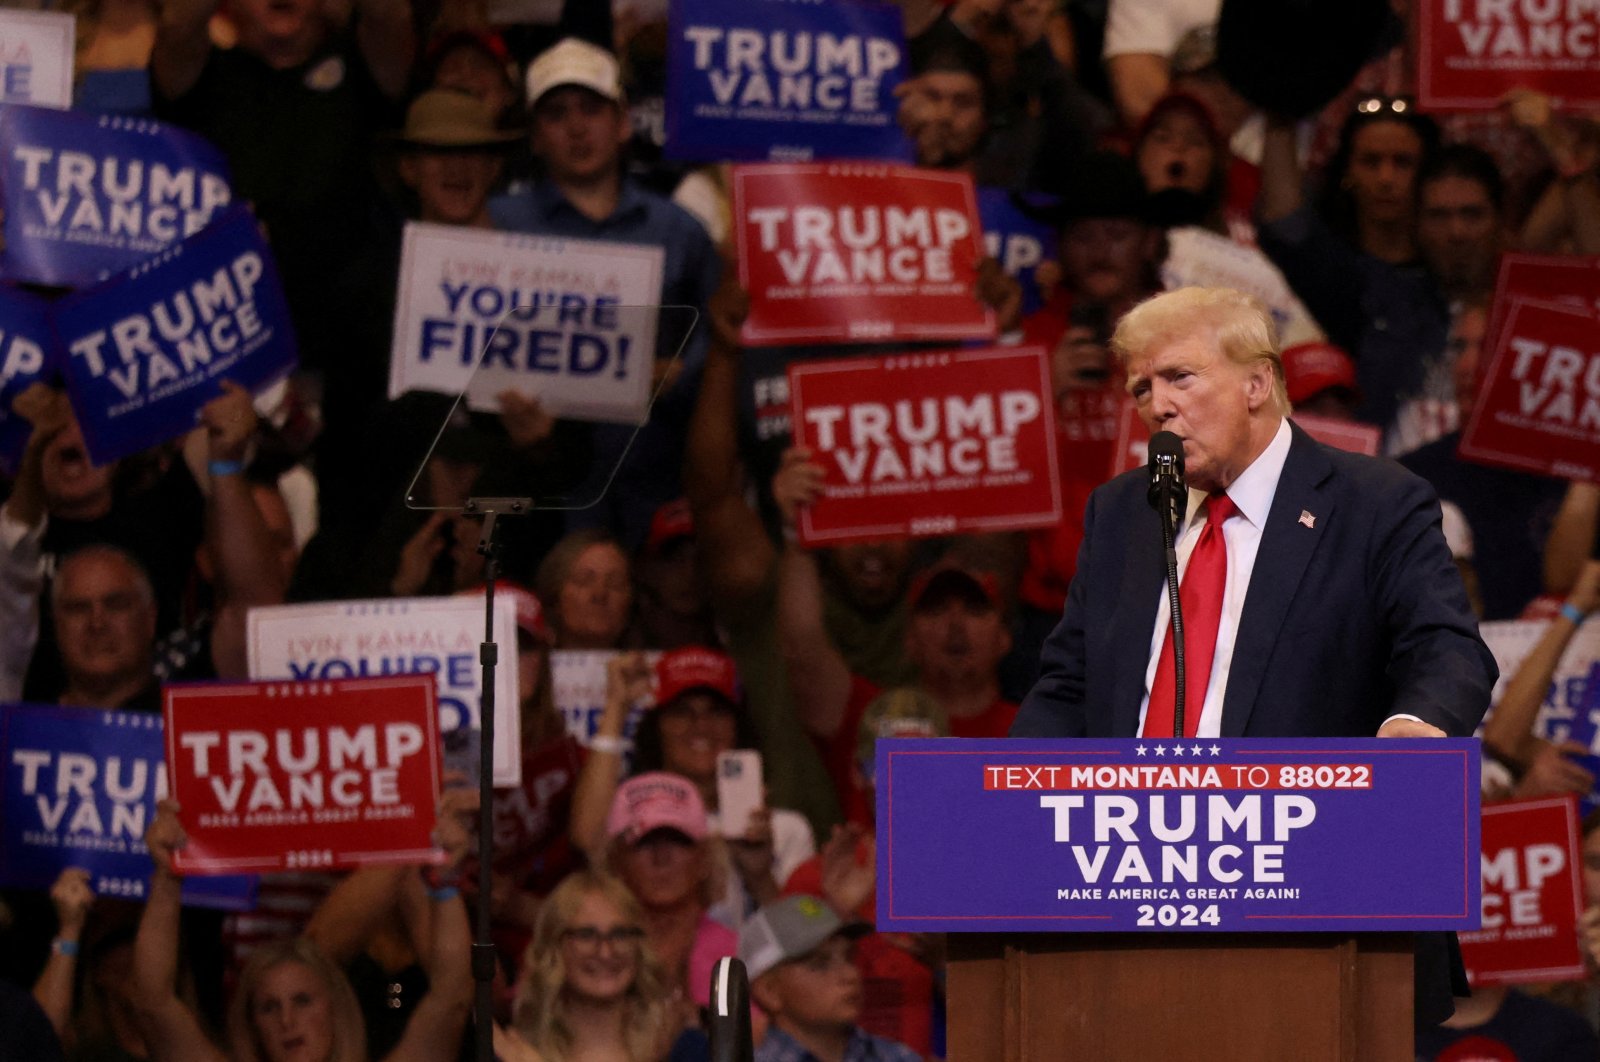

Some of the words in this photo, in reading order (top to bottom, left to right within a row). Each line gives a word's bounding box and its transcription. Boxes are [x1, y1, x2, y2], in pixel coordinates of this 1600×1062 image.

[685, 26, 900, 77] TRUMP
[708, 70, 881, 110] VANCE
[14, 145, 232, 212] TRUMP
[38, 188, 212, 240] VANCE
[750, 206, 969, 251] TRUMP
[776, 248, 955, 284] VANCE
[70, 252, 262, 377] TRUMP
[440, 280, 622, 330] YOU'RE
[107, 303, 261, 398] VANCE
[419, 318, 631, 381] FIRED!
[806, 390, 1041, 450] TRUMP
[835, 437, 1018, 483] VANCE
[181, 723, 425, 777] TRUMP
[210, 768, 401, 812] VANCE
[987, 767, 1061, 788] TEXT
[1071, 767, 1221, 788] MONTANA
[1231, 766, 1269, 788] TO
[1279, 766, 1370, 788] 88022
[1040, 795, 1317, 842] TRUMP
[1071, 845, 1285, 883] VANCE
[1057, 889, 1102, 899] MAKE
[1108, 888, 1180, 899] AMERICA
[1185, 888, 1237, 899] GREAT
[1244, 888, 1300, 899] AGAIN!
[1136, 904, 1221, 927] 2024
